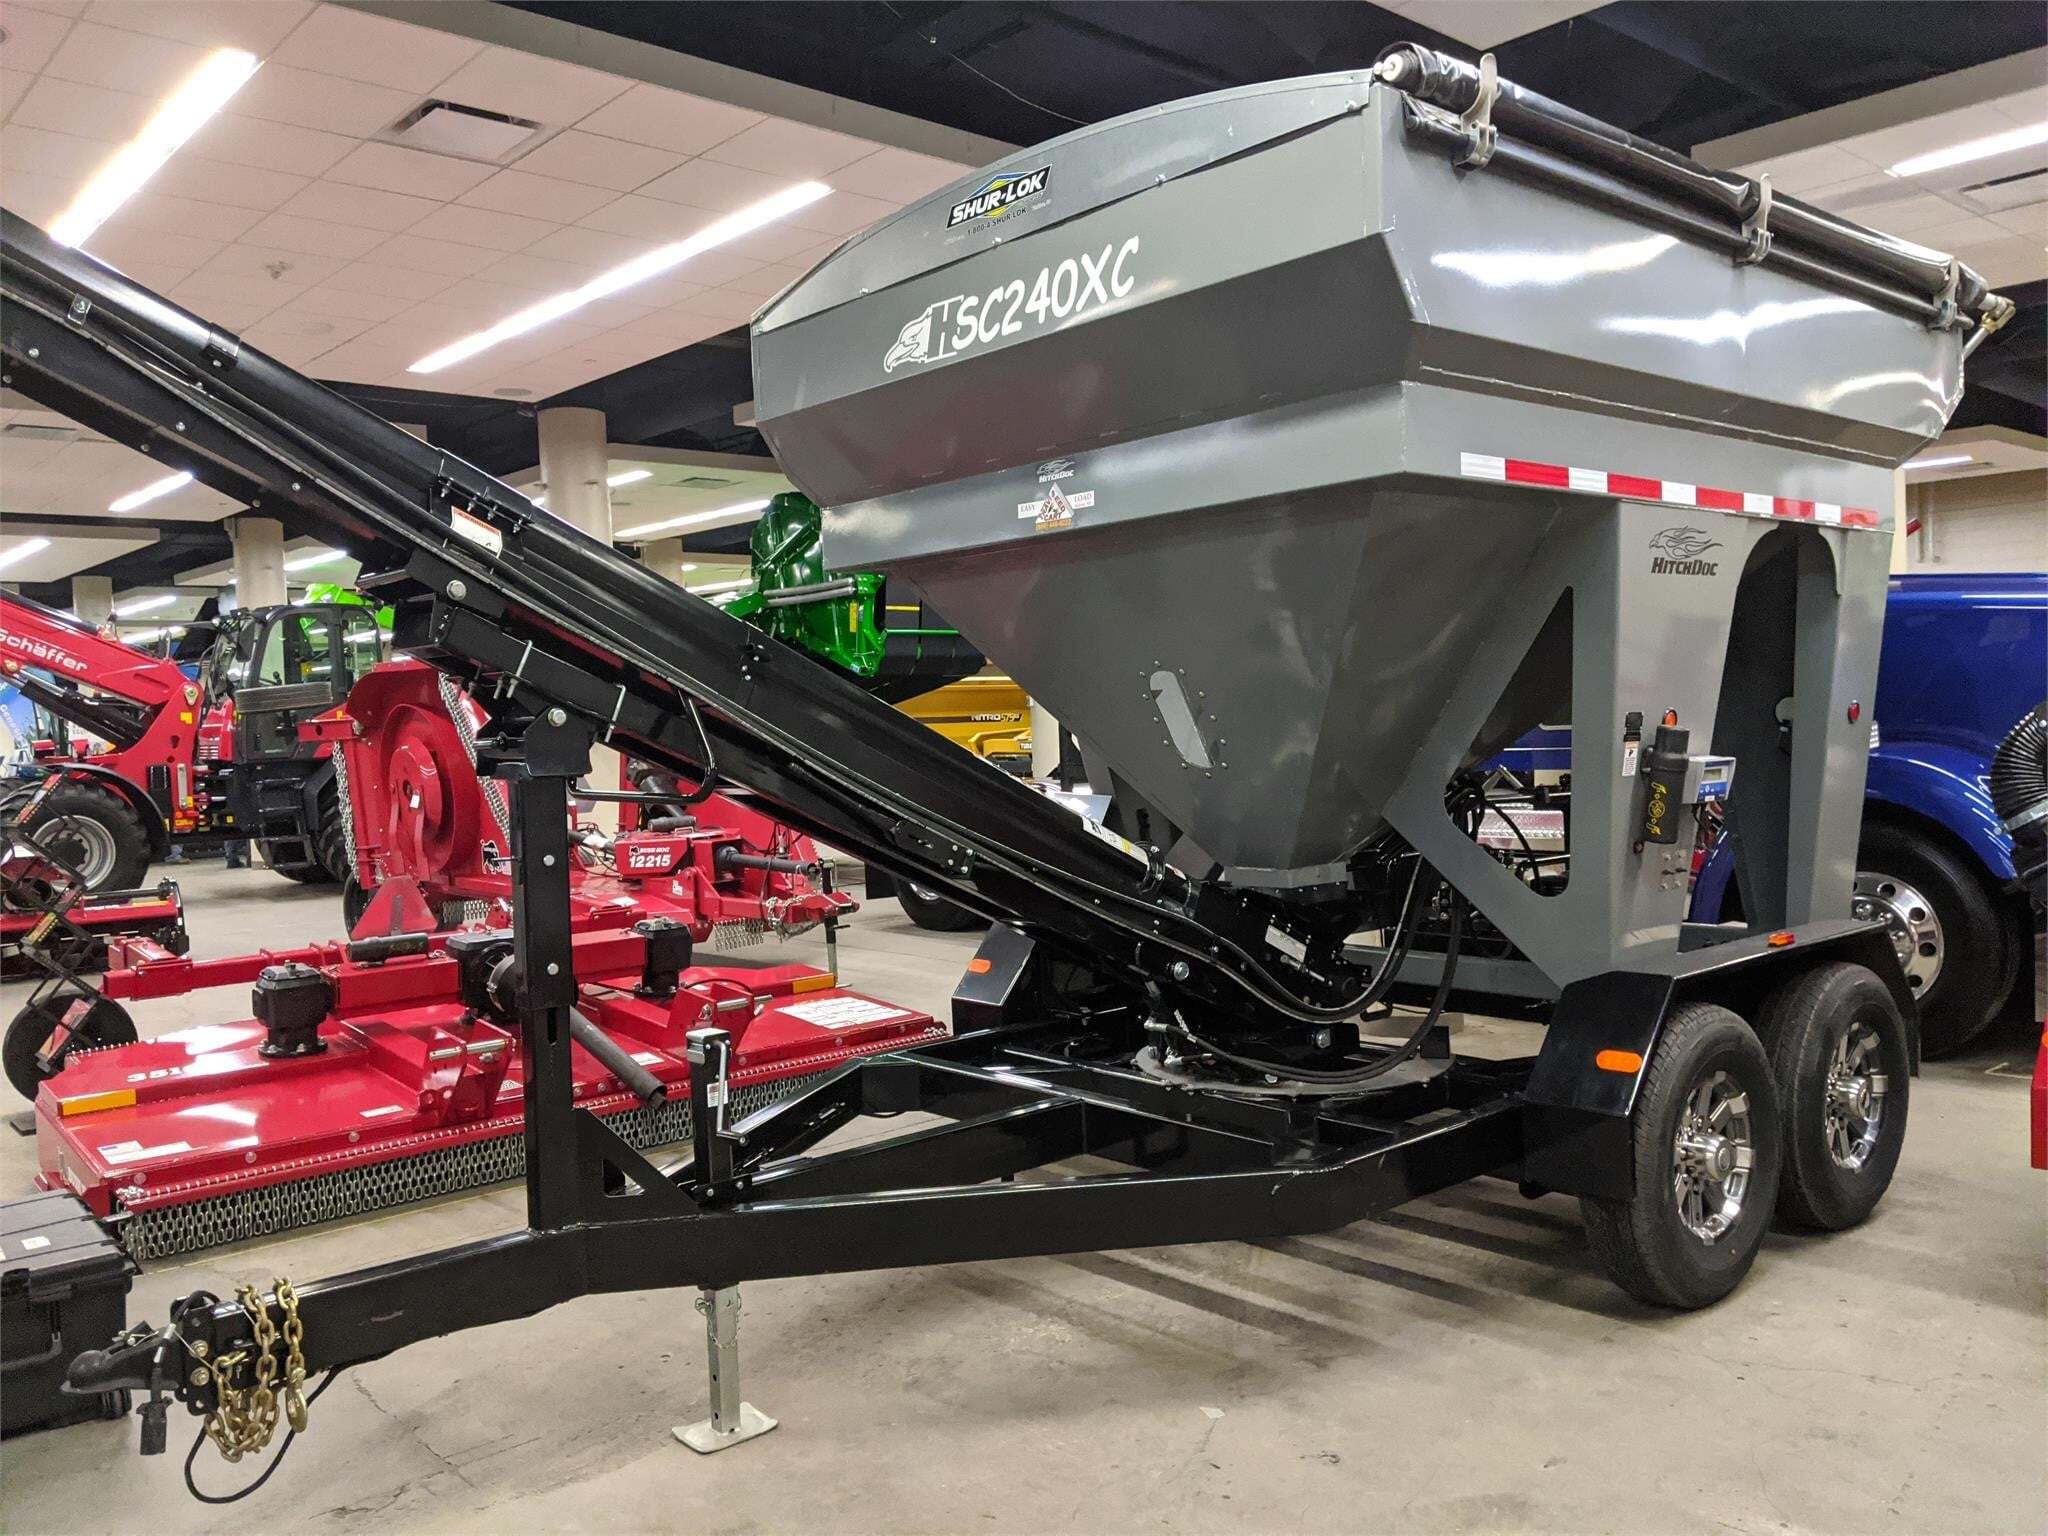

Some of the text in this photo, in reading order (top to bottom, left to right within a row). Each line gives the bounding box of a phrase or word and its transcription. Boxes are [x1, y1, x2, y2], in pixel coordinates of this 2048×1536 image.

[950, 170, 1046, 226] SHUR-LOK
[0, 628, 88, 672] Schäffer
[629, 854, 672, 868] 12215
